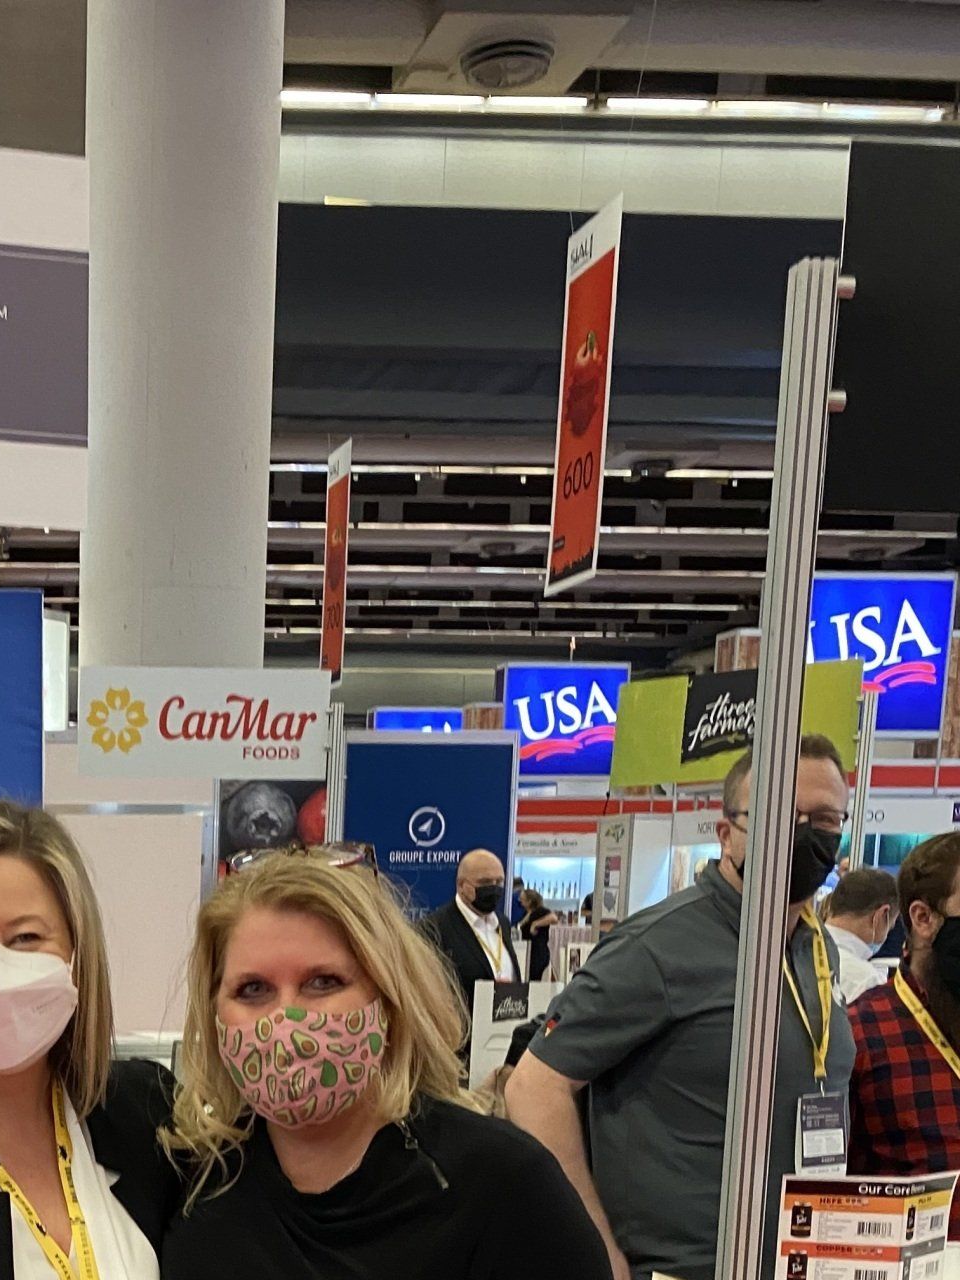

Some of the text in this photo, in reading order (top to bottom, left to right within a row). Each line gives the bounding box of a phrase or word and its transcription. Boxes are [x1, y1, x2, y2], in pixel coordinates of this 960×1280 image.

[563, 450, 594, 500] 600
[158, 693, 318, 741] CanMar
[513, 680, 617, 741] USA
[705, 691, 756, 724] three
[242, 745, 300, 760] FOODS
[389, 850, 461, 863] GROUPE EXPORT
[858, 1183, 882, 1195] Our
